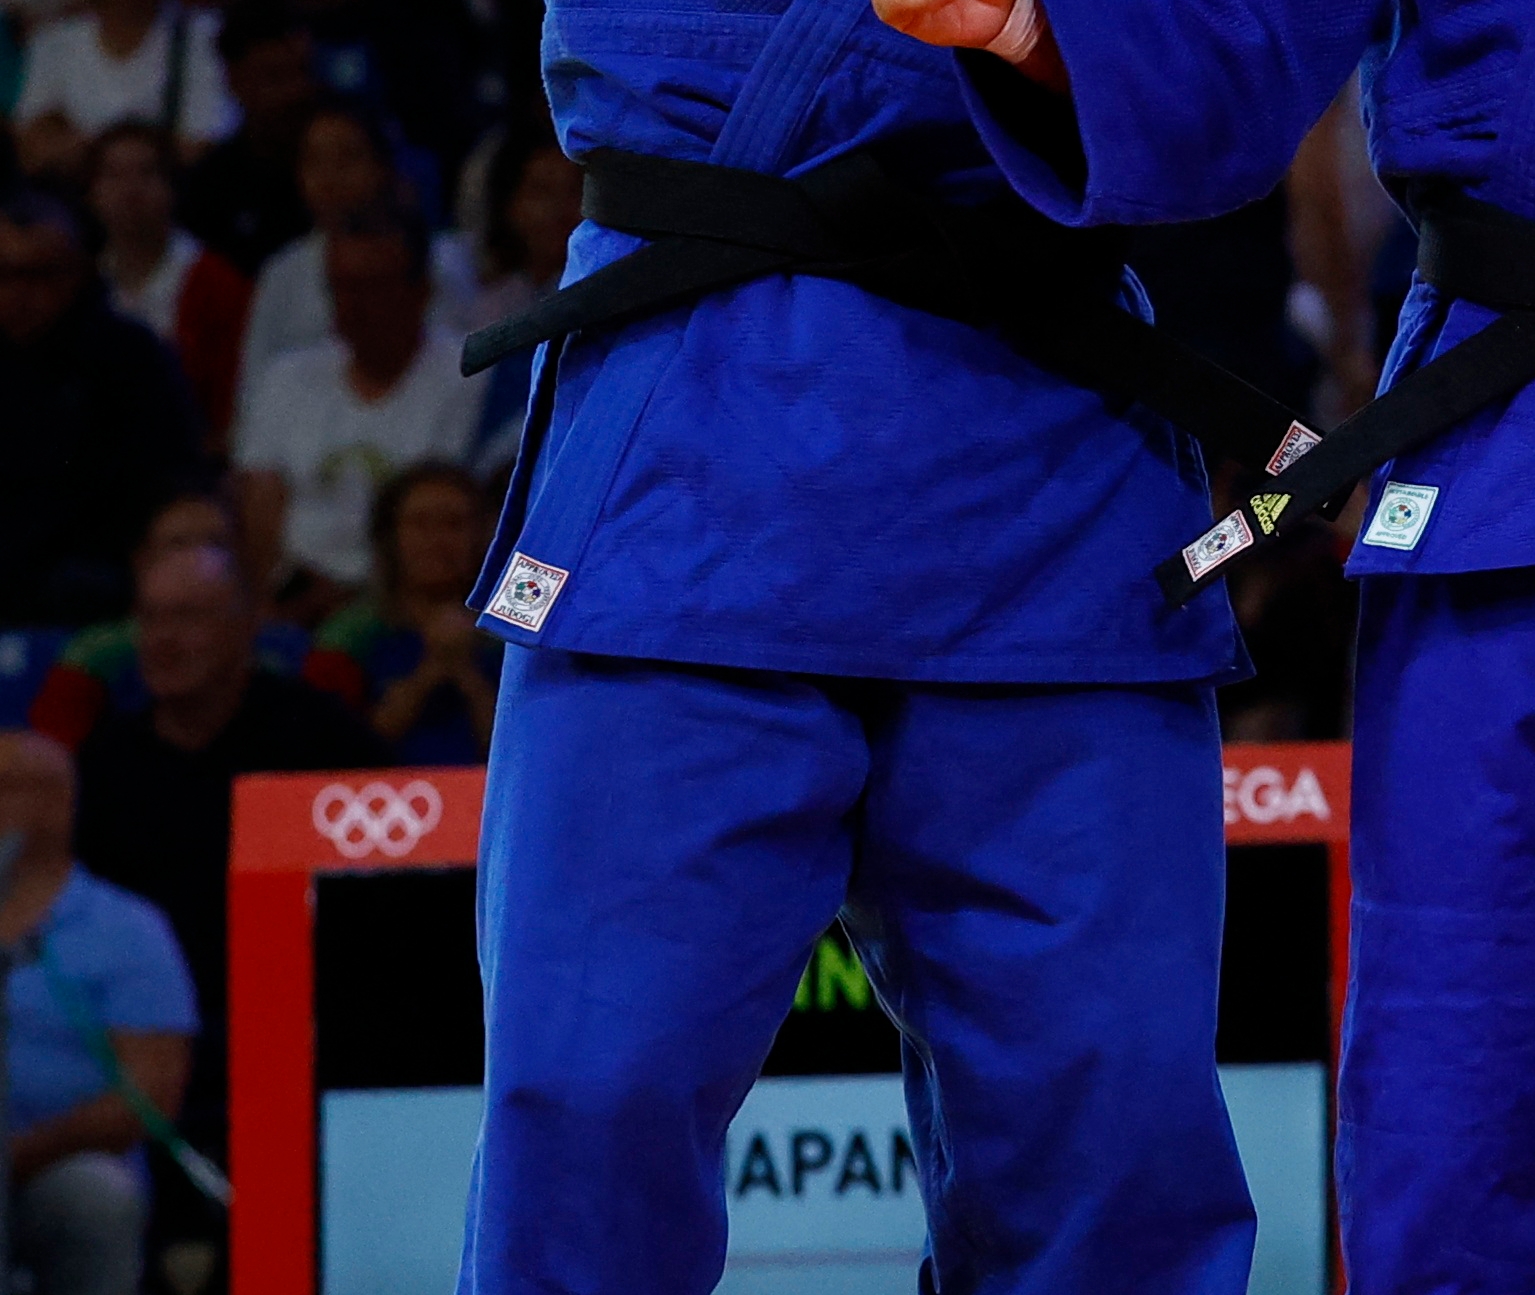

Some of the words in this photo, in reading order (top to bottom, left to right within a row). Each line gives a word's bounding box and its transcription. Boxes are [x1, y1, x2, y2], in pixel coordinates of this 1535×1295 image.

[1275, 430, 1302, 473] APPROVED
[1250, 495, 1275, 536] adidas
[518, 559, 562, 581] APPROVED
[497, 605, 535, 623] JUDOGI
